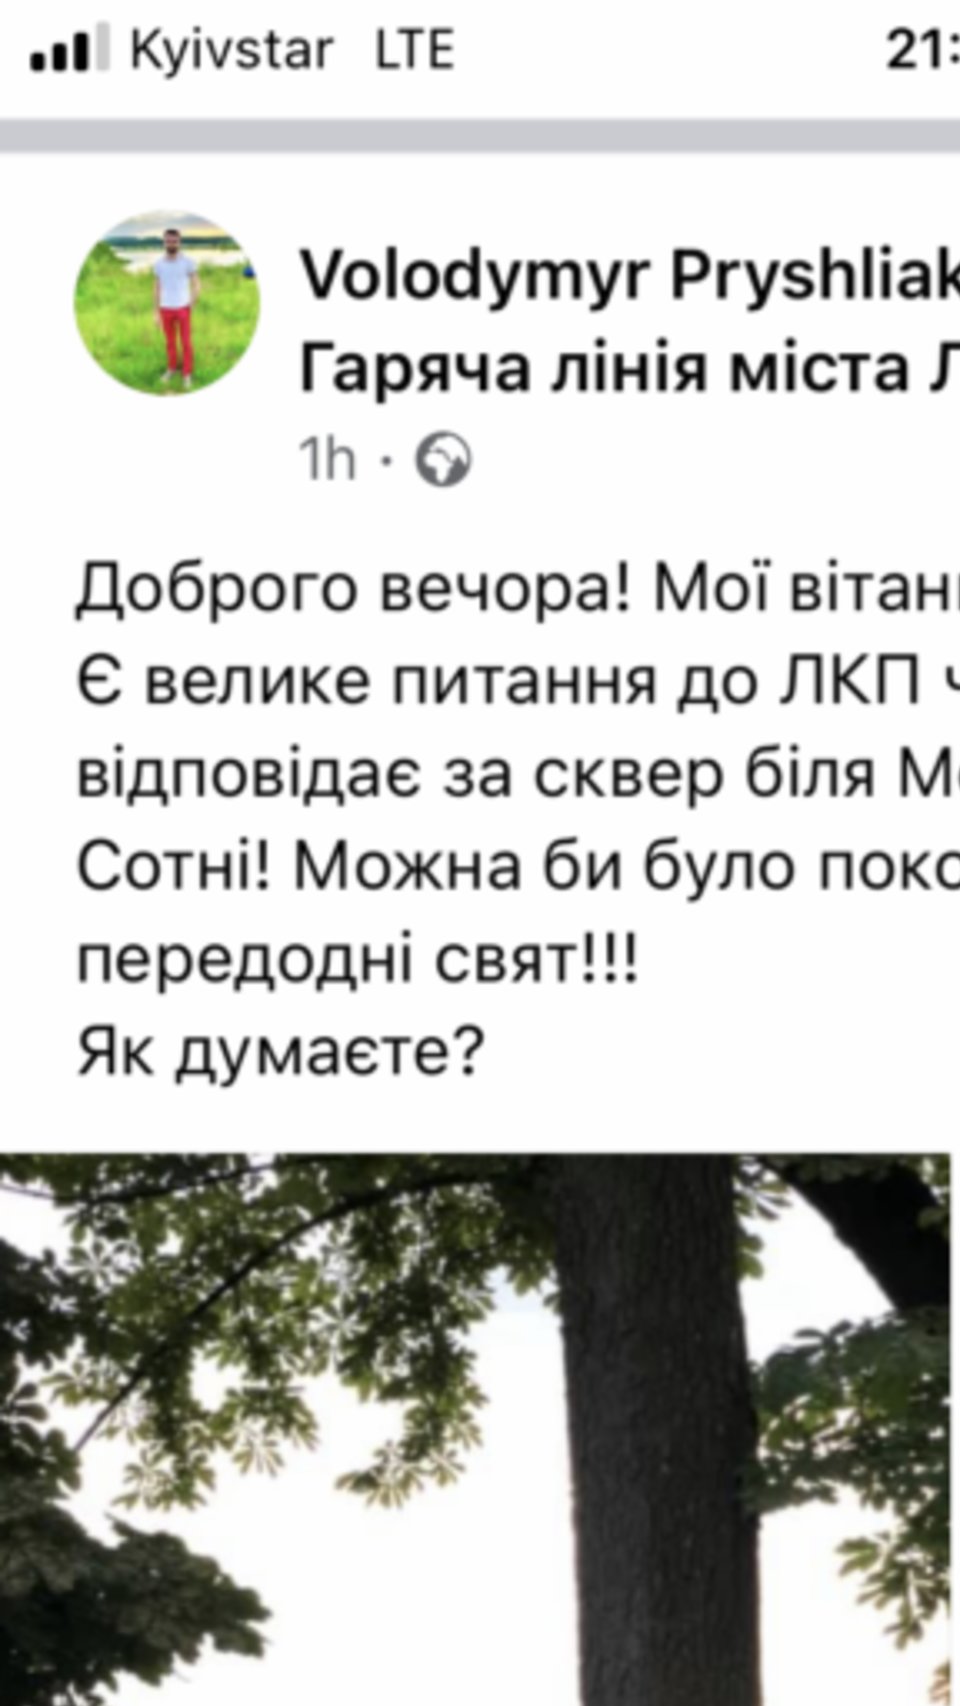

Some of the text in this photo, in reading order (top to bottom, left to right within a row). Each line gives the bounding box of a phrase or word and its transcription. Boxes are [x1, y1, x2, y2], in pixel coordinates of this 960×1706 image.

[132, 26, 453, 80] Kyivstar LTE
[299, 246, 651, 313] Volodymyr
[302, 341, 530, 404] Гаряча
[550, 337, 707, 393] лінія
[731, 337, 908, 393] міста
[301, 435, 354, 480] 1h
[74, 558, 357, 624] Доброго
[382, 560, 628, 624] вечора!
[656, 558, 771, 612] Мої
[78, 652, 121, 706] Є
[146, 665, 370, 705] велике
[394, 665, 655, 705] питання
[677, 665, 758, 714] до
[779, 653, 918, 704] ЛКП
[79, 743, 420, 807] відповідає
[444, 758, 511, 798] за
[535, 758, 724, 810] сквер
[746, 743, 874, 798] біля
[78, 836, 268, 891] Сотні!
[296, 839, 520, 891] Можна
[544, 836, 621, 891] би
[644, 836, 795, 903] було
[79, 929, 637, 995] передодні свят!!!
[79, 1024, 484, 1088] Як думаєте?
